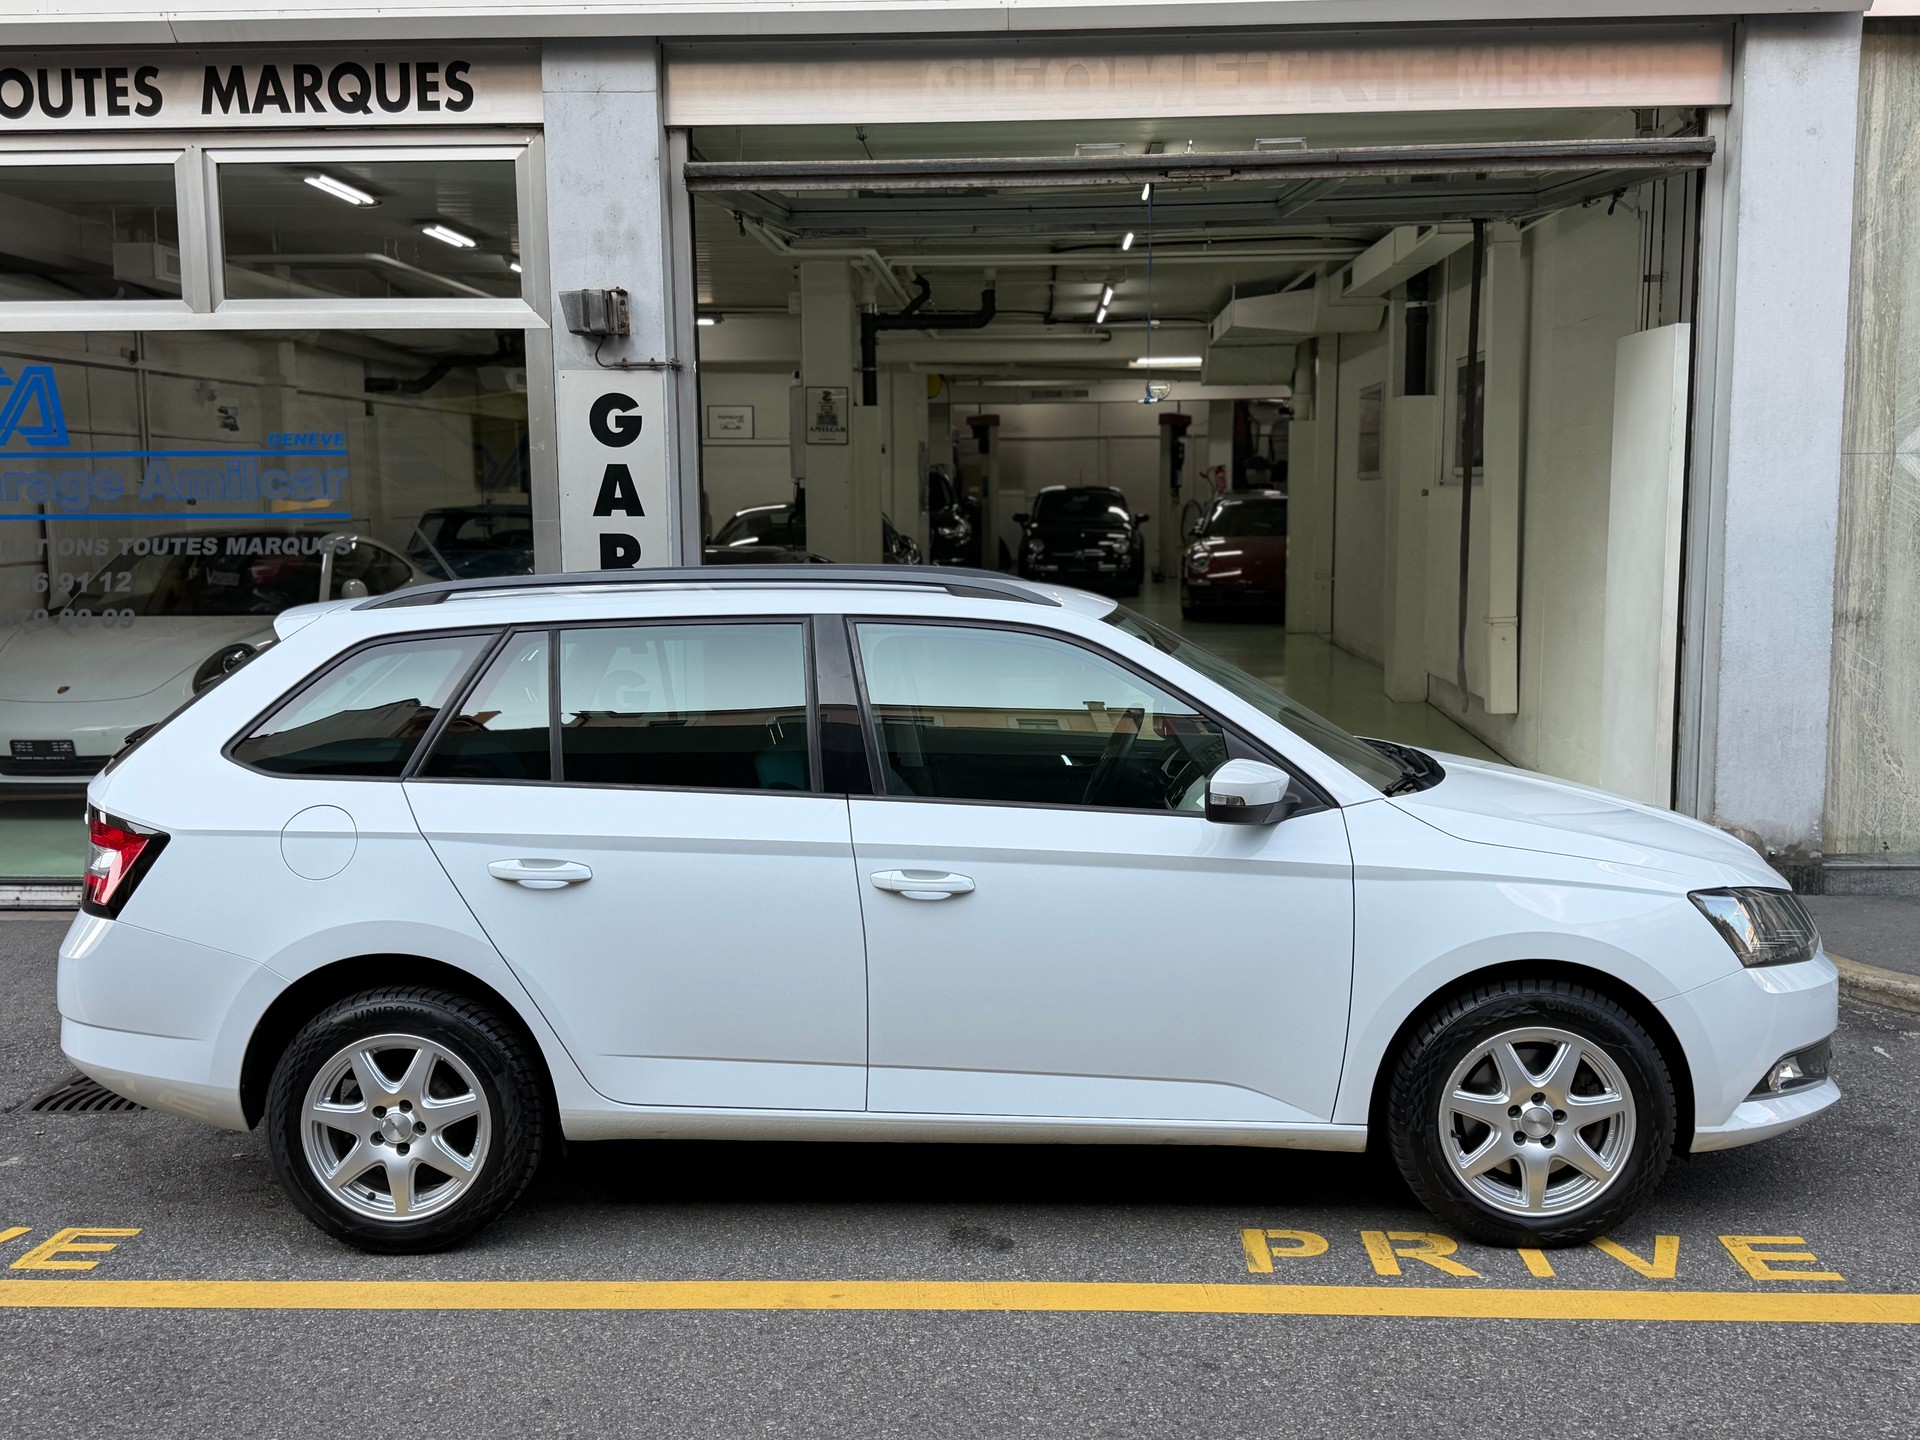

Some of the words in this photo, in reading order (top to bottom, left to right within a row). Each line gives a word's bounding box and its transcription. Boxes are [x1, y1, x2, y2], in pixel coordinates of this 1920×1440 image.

[201, 60, 475, 115] MARQUES
[139, 459, 349, 501] Amilcar
[118, 537, 218, 556] TOUTES
[99, 571, 133, 593] 12
